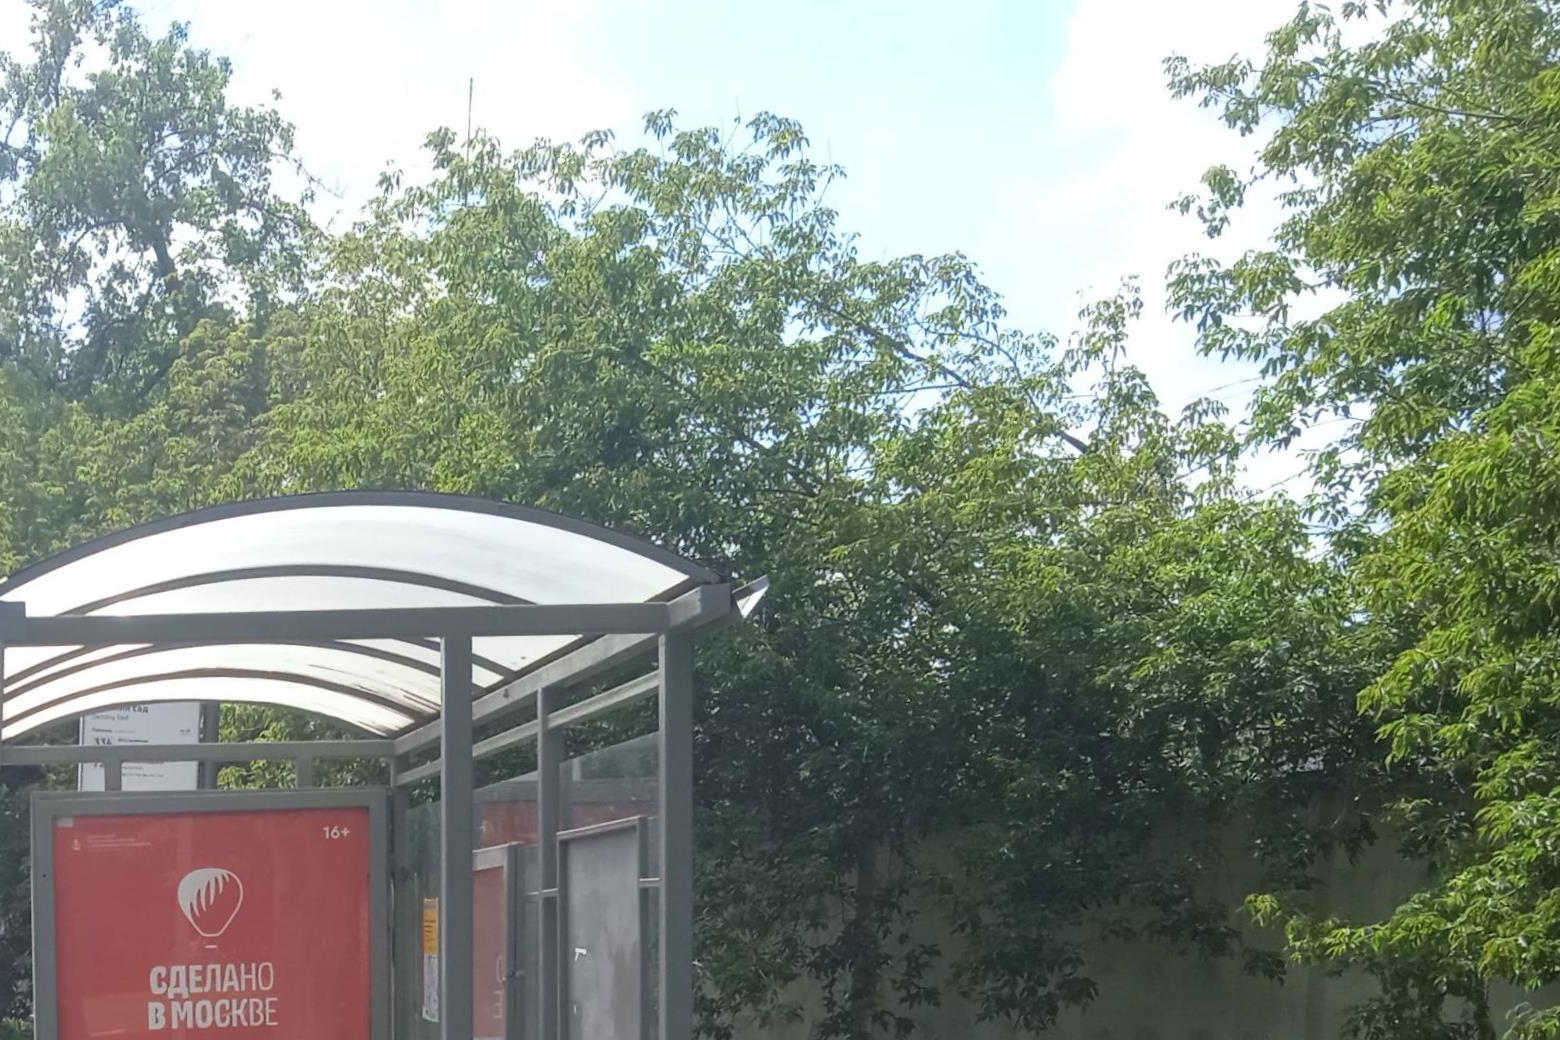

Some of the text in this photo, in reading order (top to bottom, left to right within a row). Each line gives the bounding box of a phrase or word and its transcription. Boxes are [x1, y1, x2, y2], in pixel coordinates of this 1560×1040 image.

[323, 825, 351, 840] 16+
[149, 961, 275, 999] СДЕЛАНО
[148, 997, 279, 1030] В МОСКВЕ
